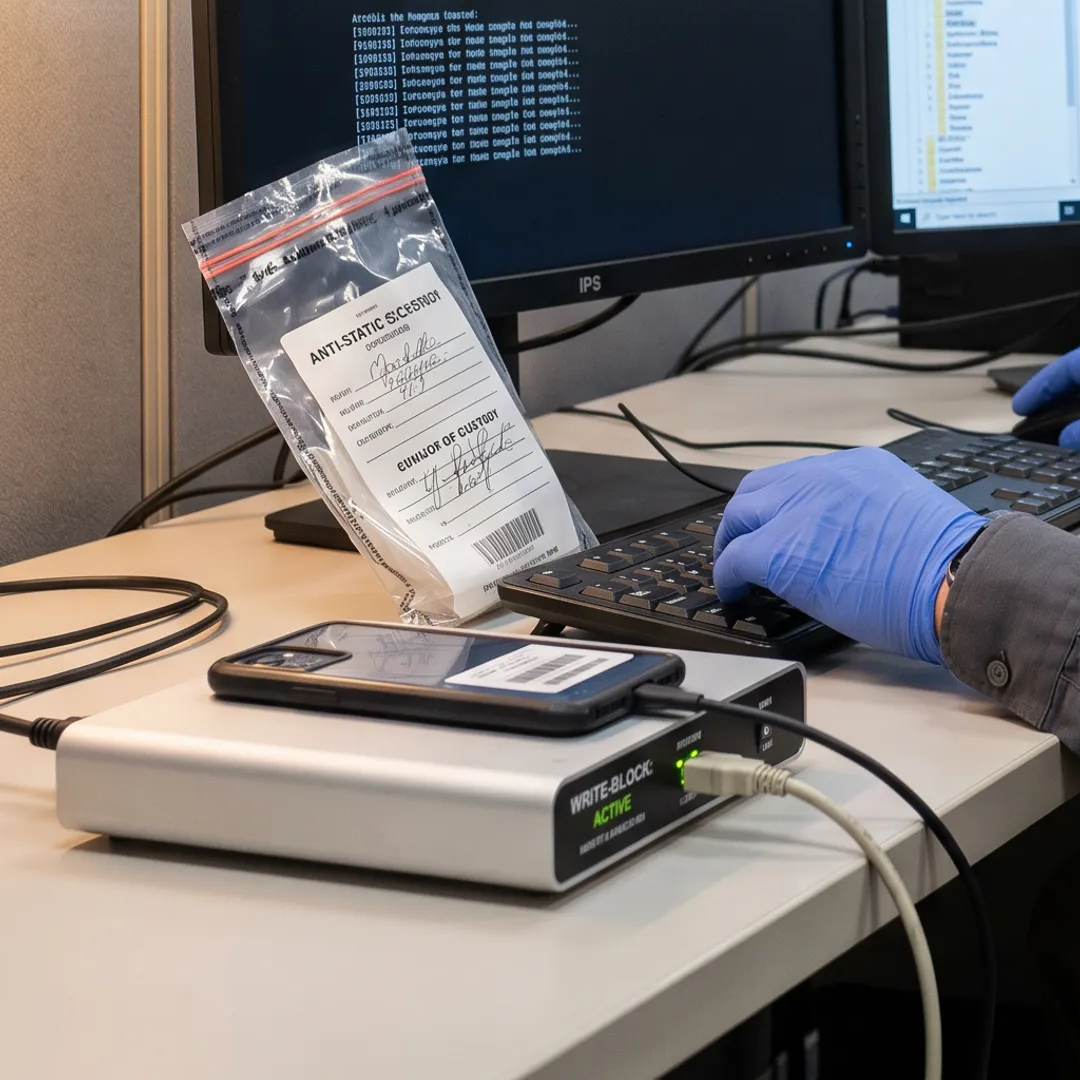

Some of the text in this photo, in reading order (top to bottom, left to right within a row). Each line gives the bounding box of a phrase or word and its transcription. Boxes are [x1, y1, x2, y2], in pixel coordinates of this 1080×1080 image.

[579, 275, 601, 293] IPS
[310, 317, 385, 366] ANTI-STATIC
[441, 431, 457, 447] OF
[570, 759, 653, 815] WRITE-BLOCK:
[592, 792, 633, 829] ACTIVE
